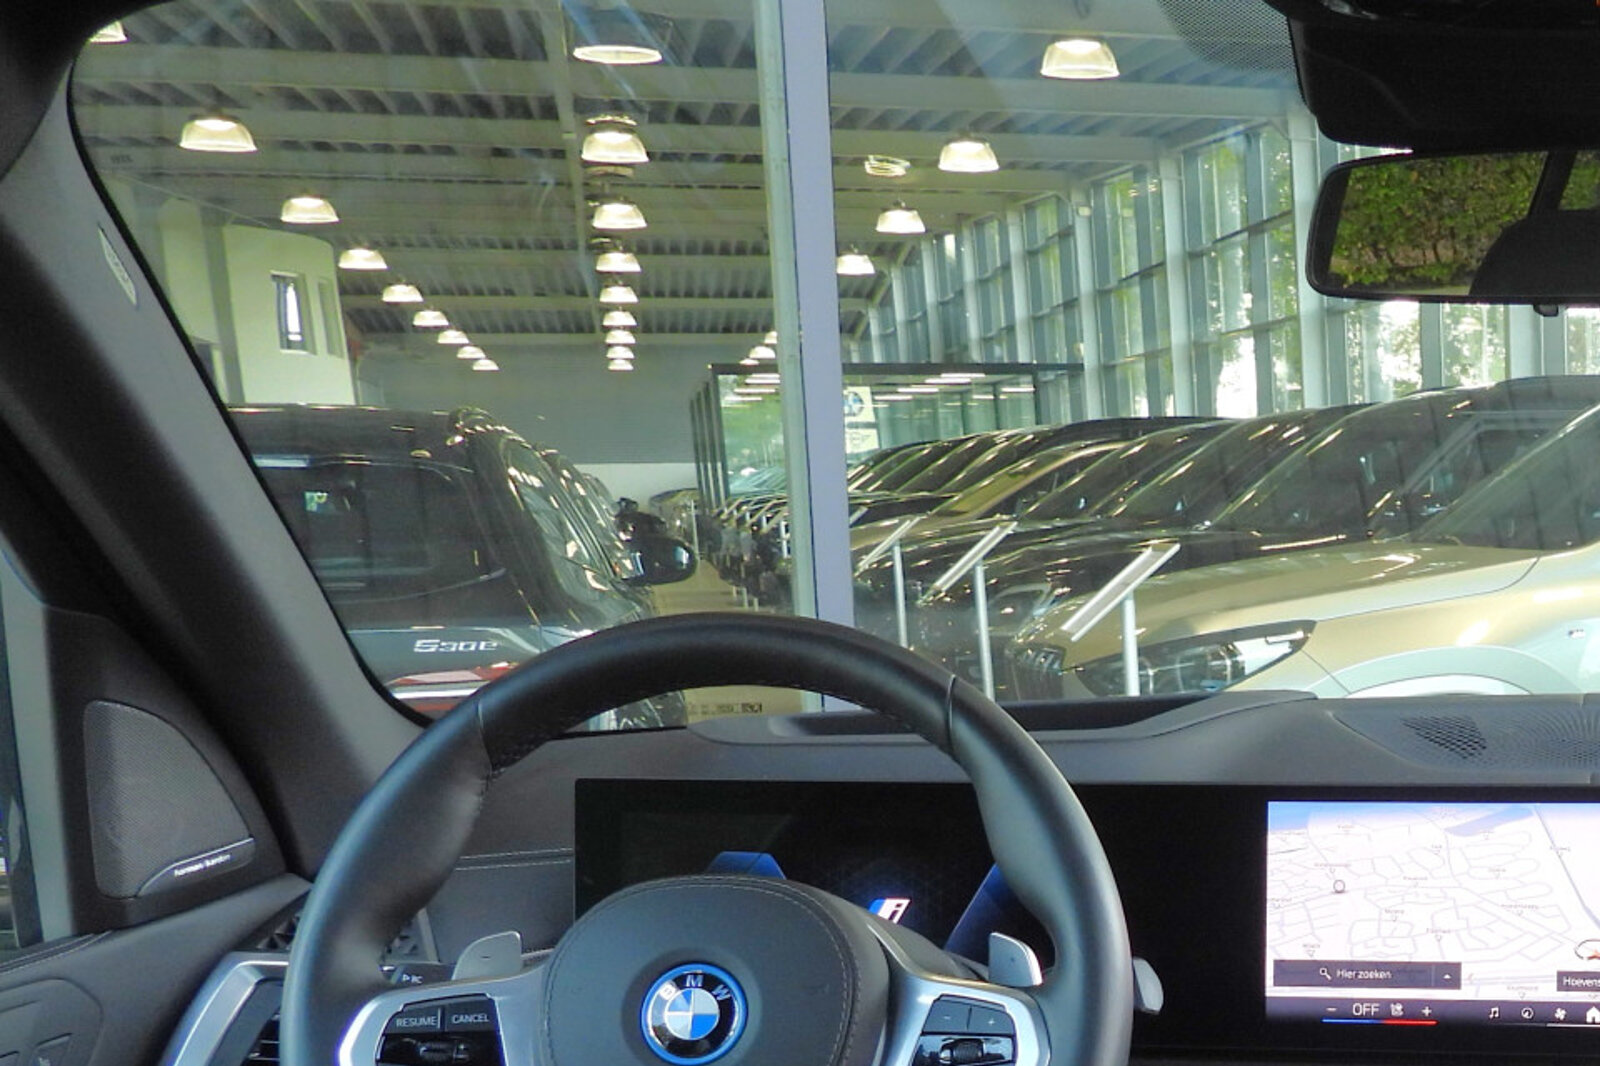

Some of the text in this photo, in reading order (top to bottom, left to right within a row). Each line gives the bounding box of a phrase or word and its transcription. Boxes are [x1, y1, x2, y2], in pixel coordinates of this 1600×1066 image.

[1336, 968, 1392, 980] Hier zoeken
[658, 974, 732, 1001] BMW
[1352, 1003, 1380, 1016] OFF
[396, 1015, 437, 1027] RESUME
[451, 1013, 489, 1024] CANCEL
